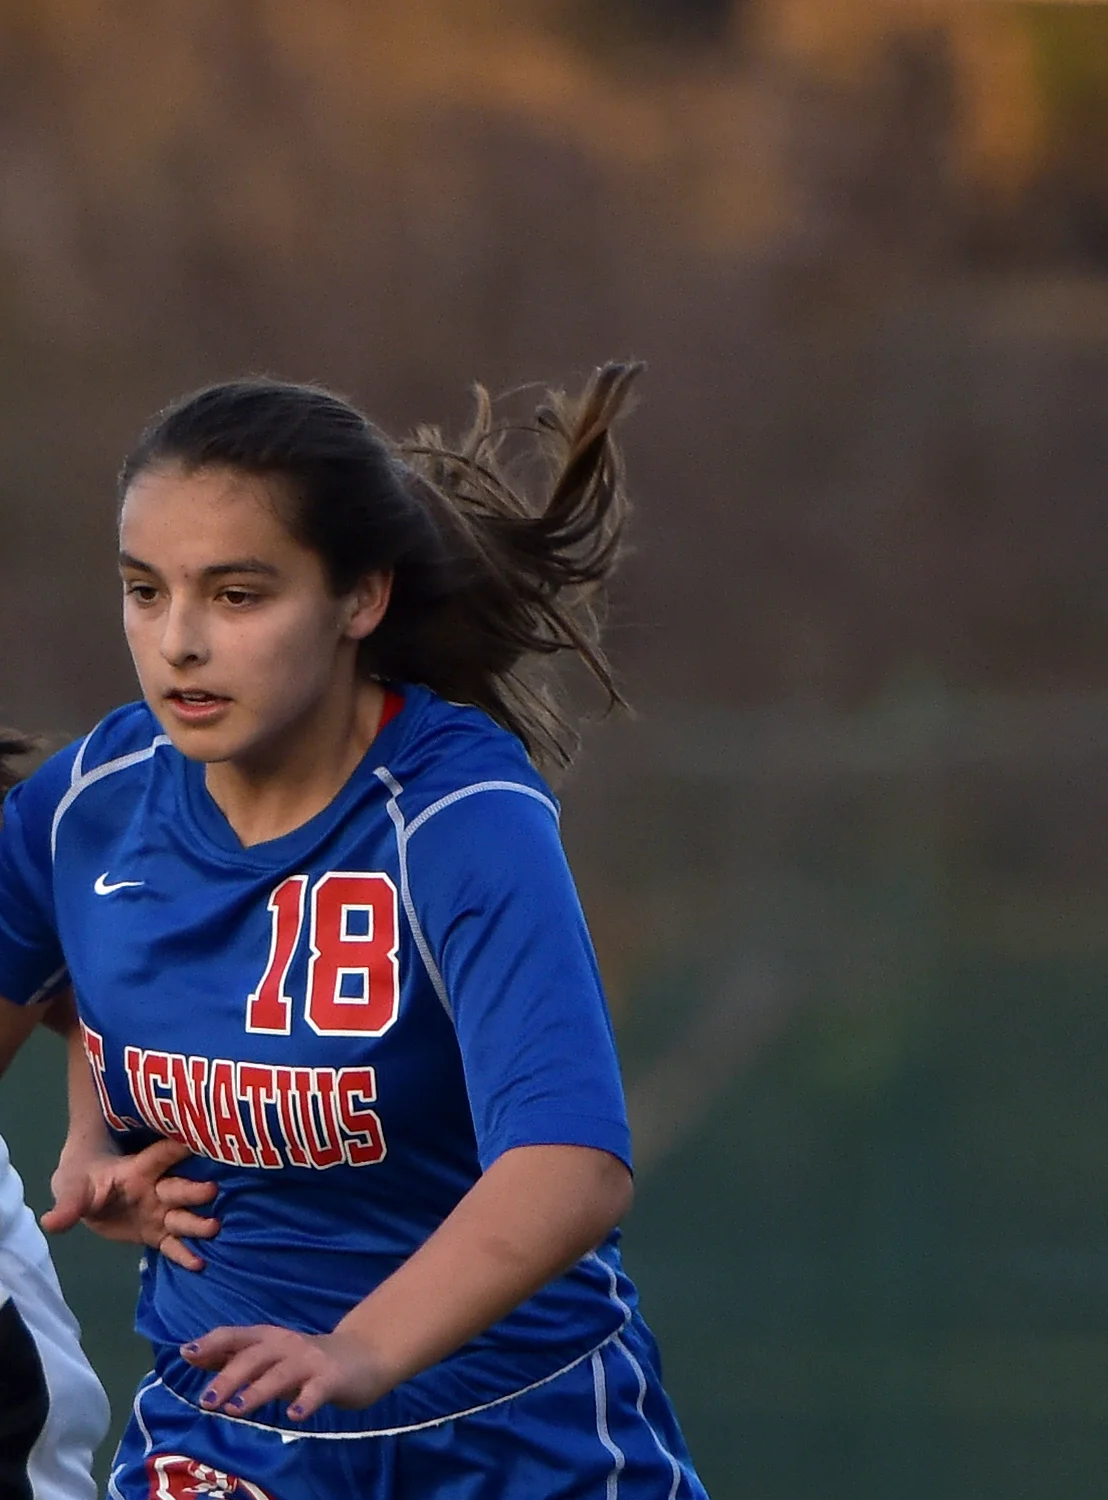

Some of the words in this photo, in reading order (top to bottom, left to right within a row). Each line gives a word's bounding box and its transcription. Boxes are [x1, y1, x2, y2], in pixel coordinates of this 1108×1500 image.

[245, 871, 400, 1037] 18
[79, 1017, 143, 1131] T.
[124, 1046, 387, 1170] IGNATIUS
